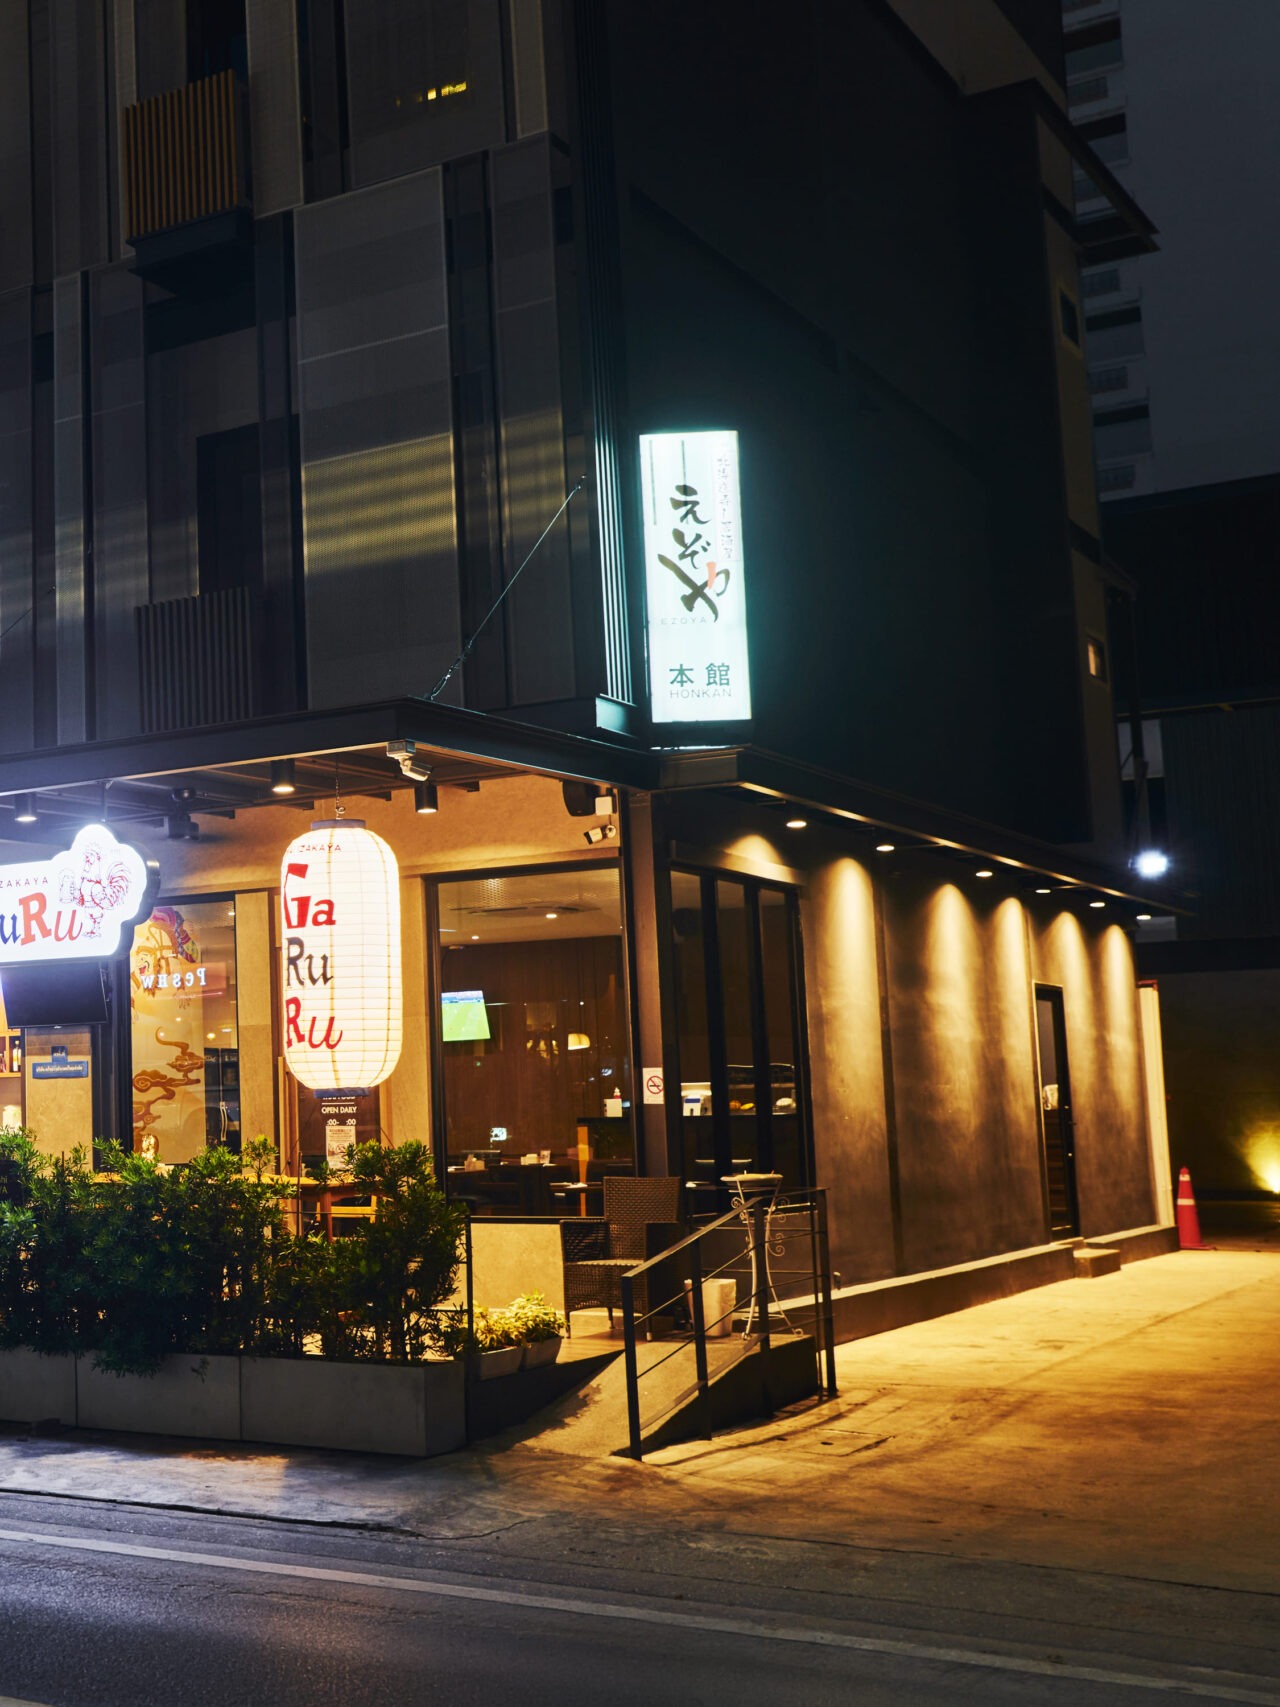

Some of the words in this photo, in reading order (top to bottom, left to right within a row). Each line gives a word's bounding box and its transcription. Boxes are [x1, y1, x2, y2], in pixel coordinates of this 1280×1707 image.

[657, 484, 731, 623] えぞや
[660, 616, 707, 626] EZOYA
[668, 662, 731, 688] 本館
[669, 687, 732, 699] HONKAN
[283, 863, 336, 929] Ga
[286, 936, 334, 988] Ru
[285, 996, 343, 1050] Ru
[321, 1106, 339, 1114] OPEN
[340, 1106, 357, 1114] DAILY
